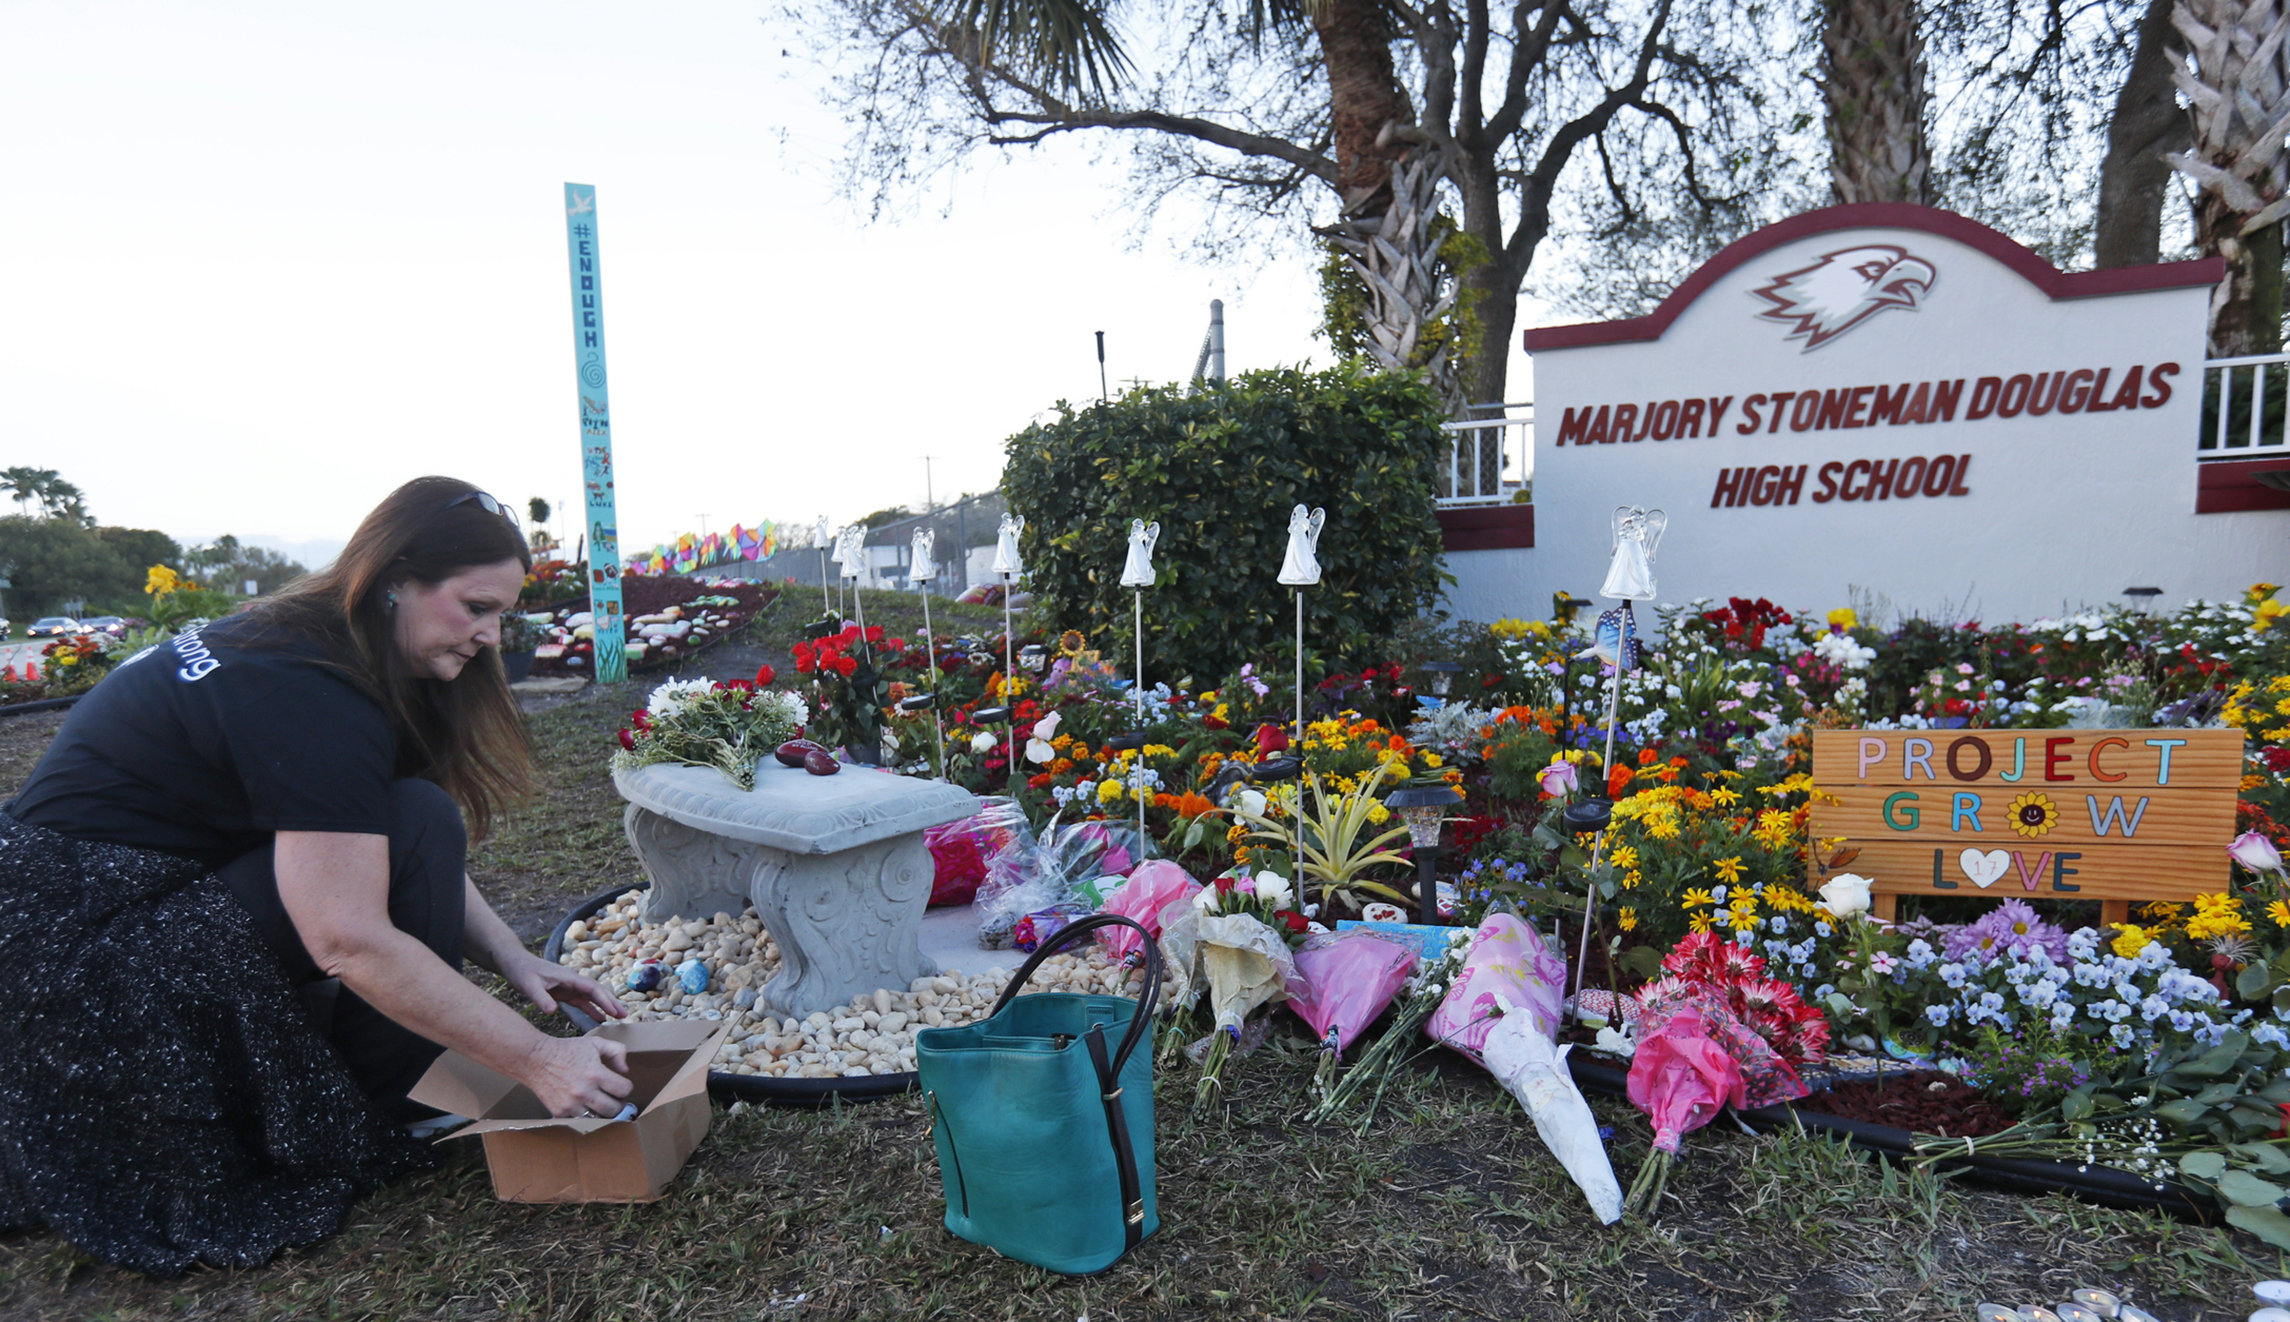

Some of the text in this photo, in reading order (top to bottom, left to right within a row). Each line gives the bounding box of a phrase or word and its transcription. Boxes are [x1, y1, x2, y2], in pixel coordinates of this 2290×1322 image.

[574, 222, 598, 348] #ENOUGH
[1557, 362, 2181, 444] MARJORY STONEMAN DOUGLAS
[1711, 455, 1971, 508] HIGH SCHOOL
[1857, 735, 2188, 785] PROJECT
